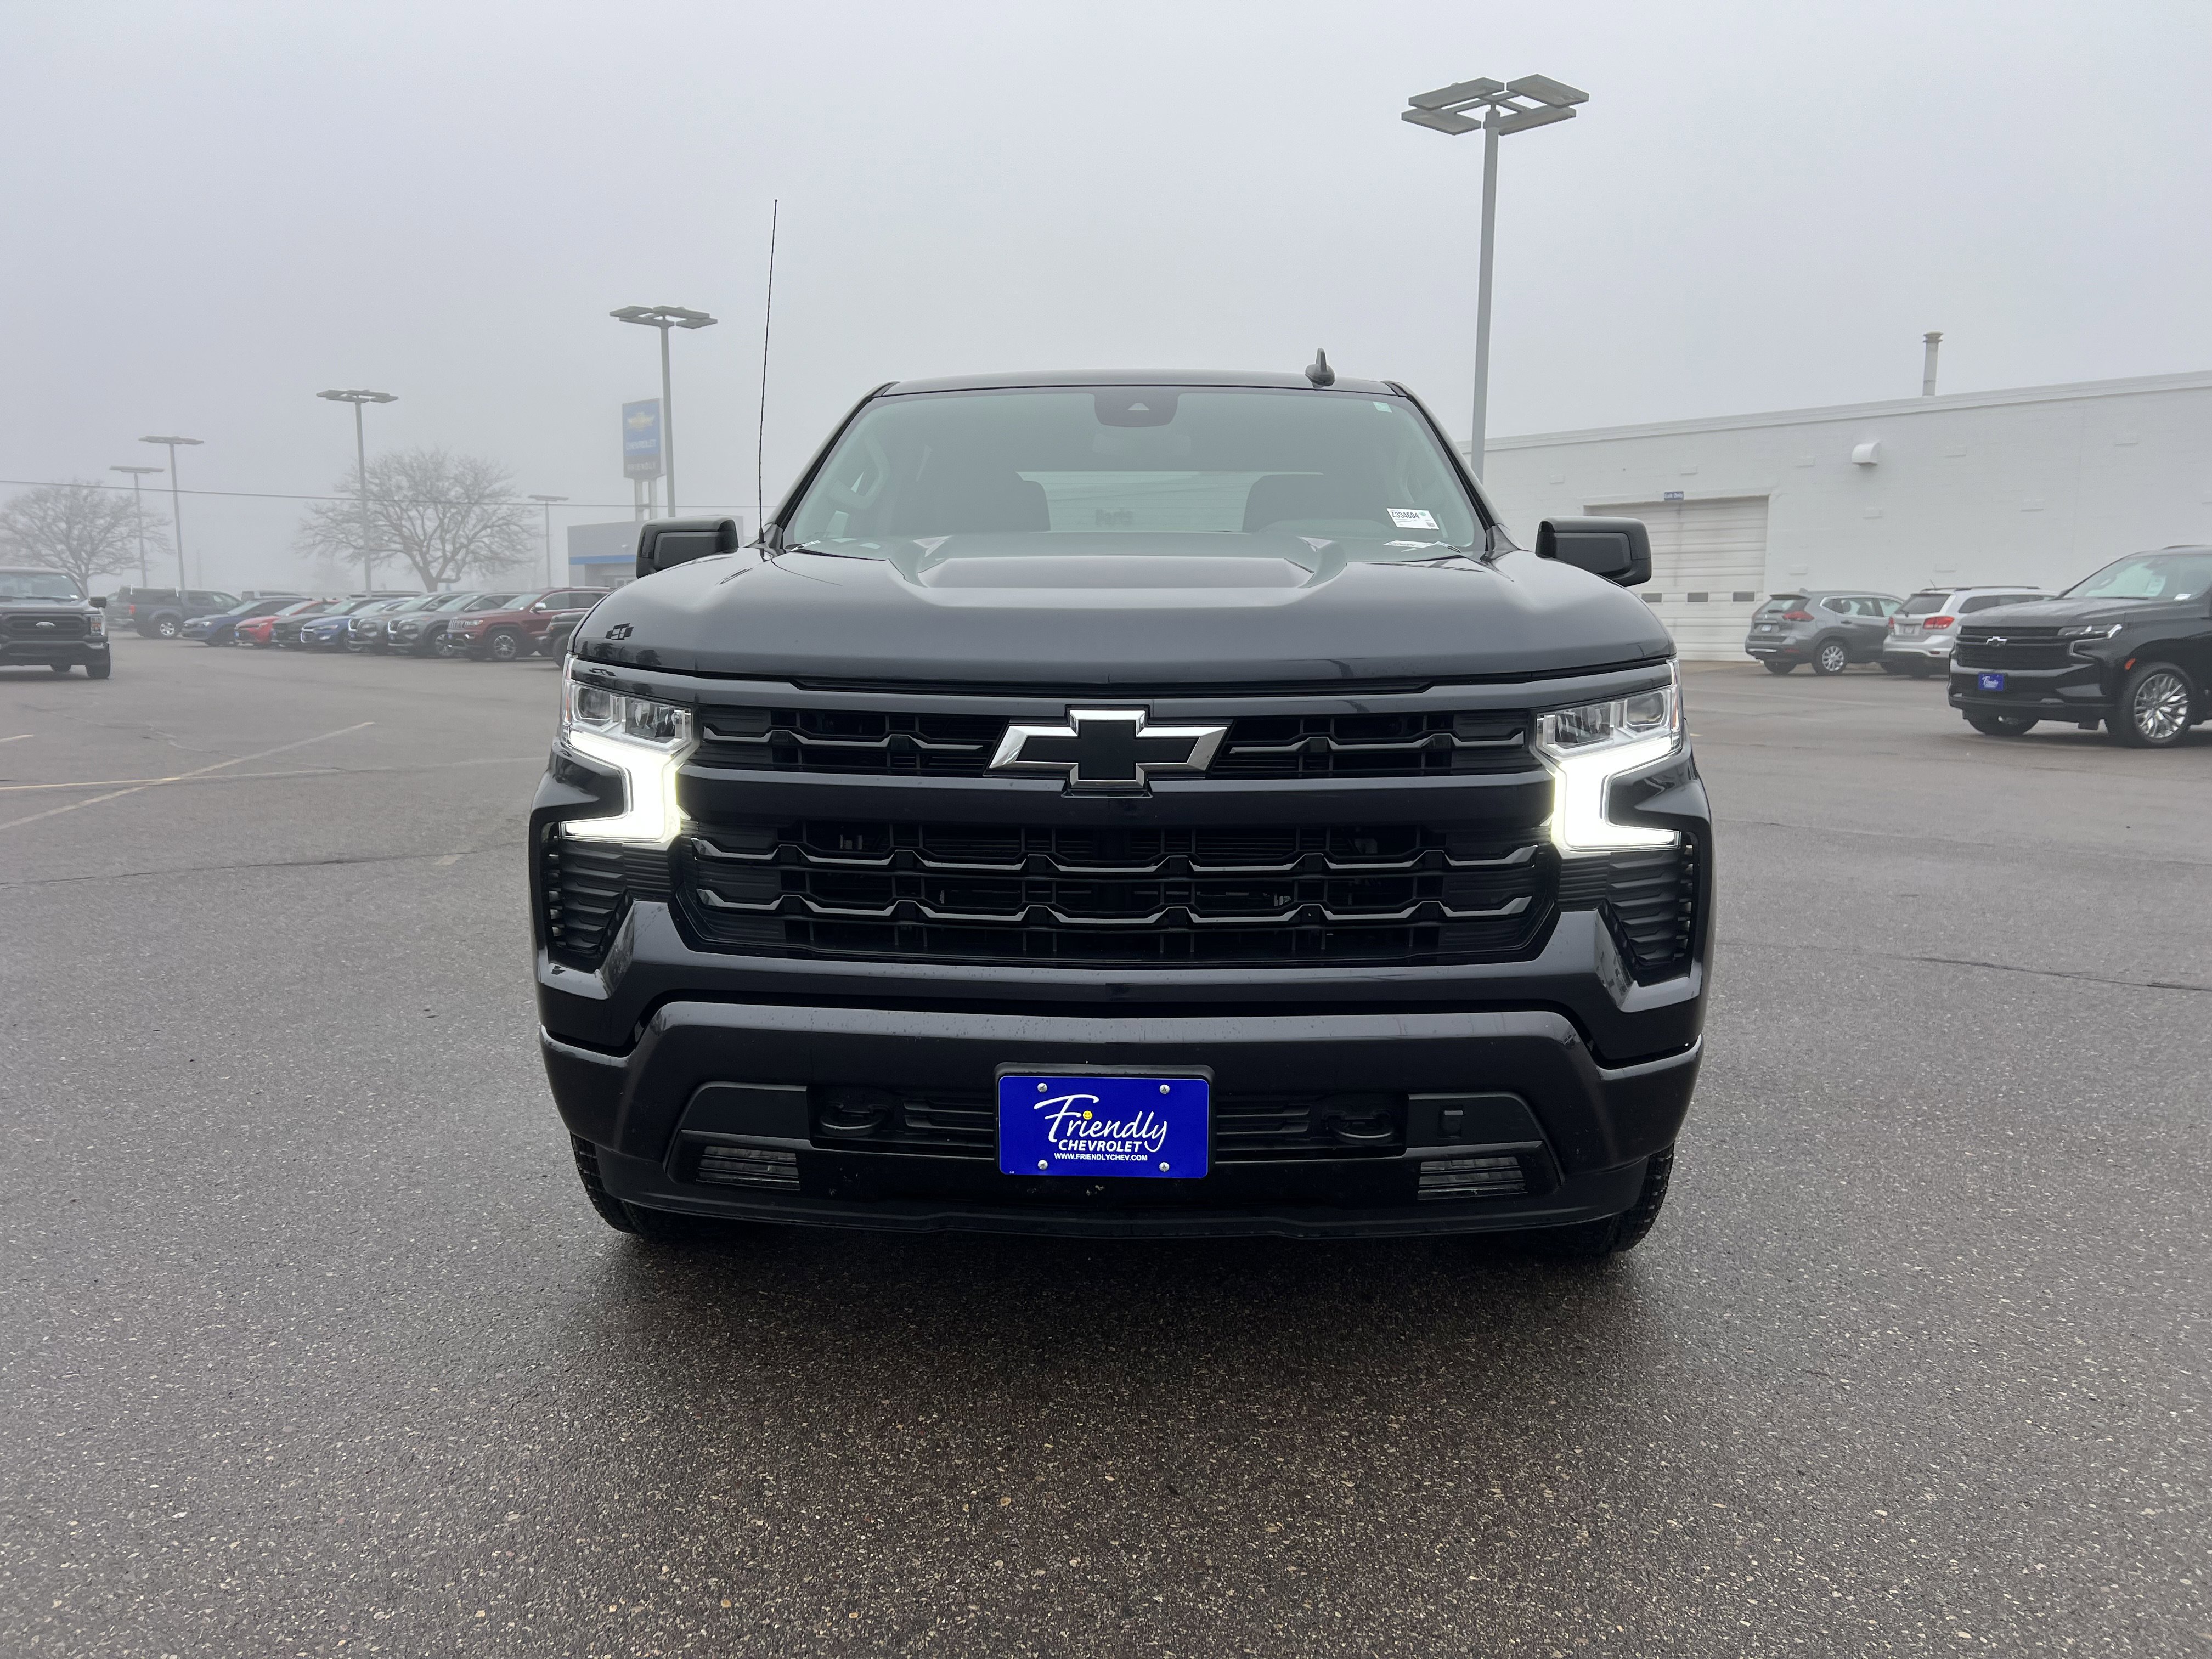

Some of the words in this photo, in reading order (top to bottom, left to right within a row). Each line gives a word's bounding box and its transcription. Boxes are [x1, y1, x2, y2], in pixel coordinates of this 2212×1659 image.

[1034, 1094, 1167, 1152] Friendly
[1058, 1139, 1142, 1152] CHEVROLET
[1054, 1153, 1148, 1161] WWW.FRIENDLYCHEV.COM
